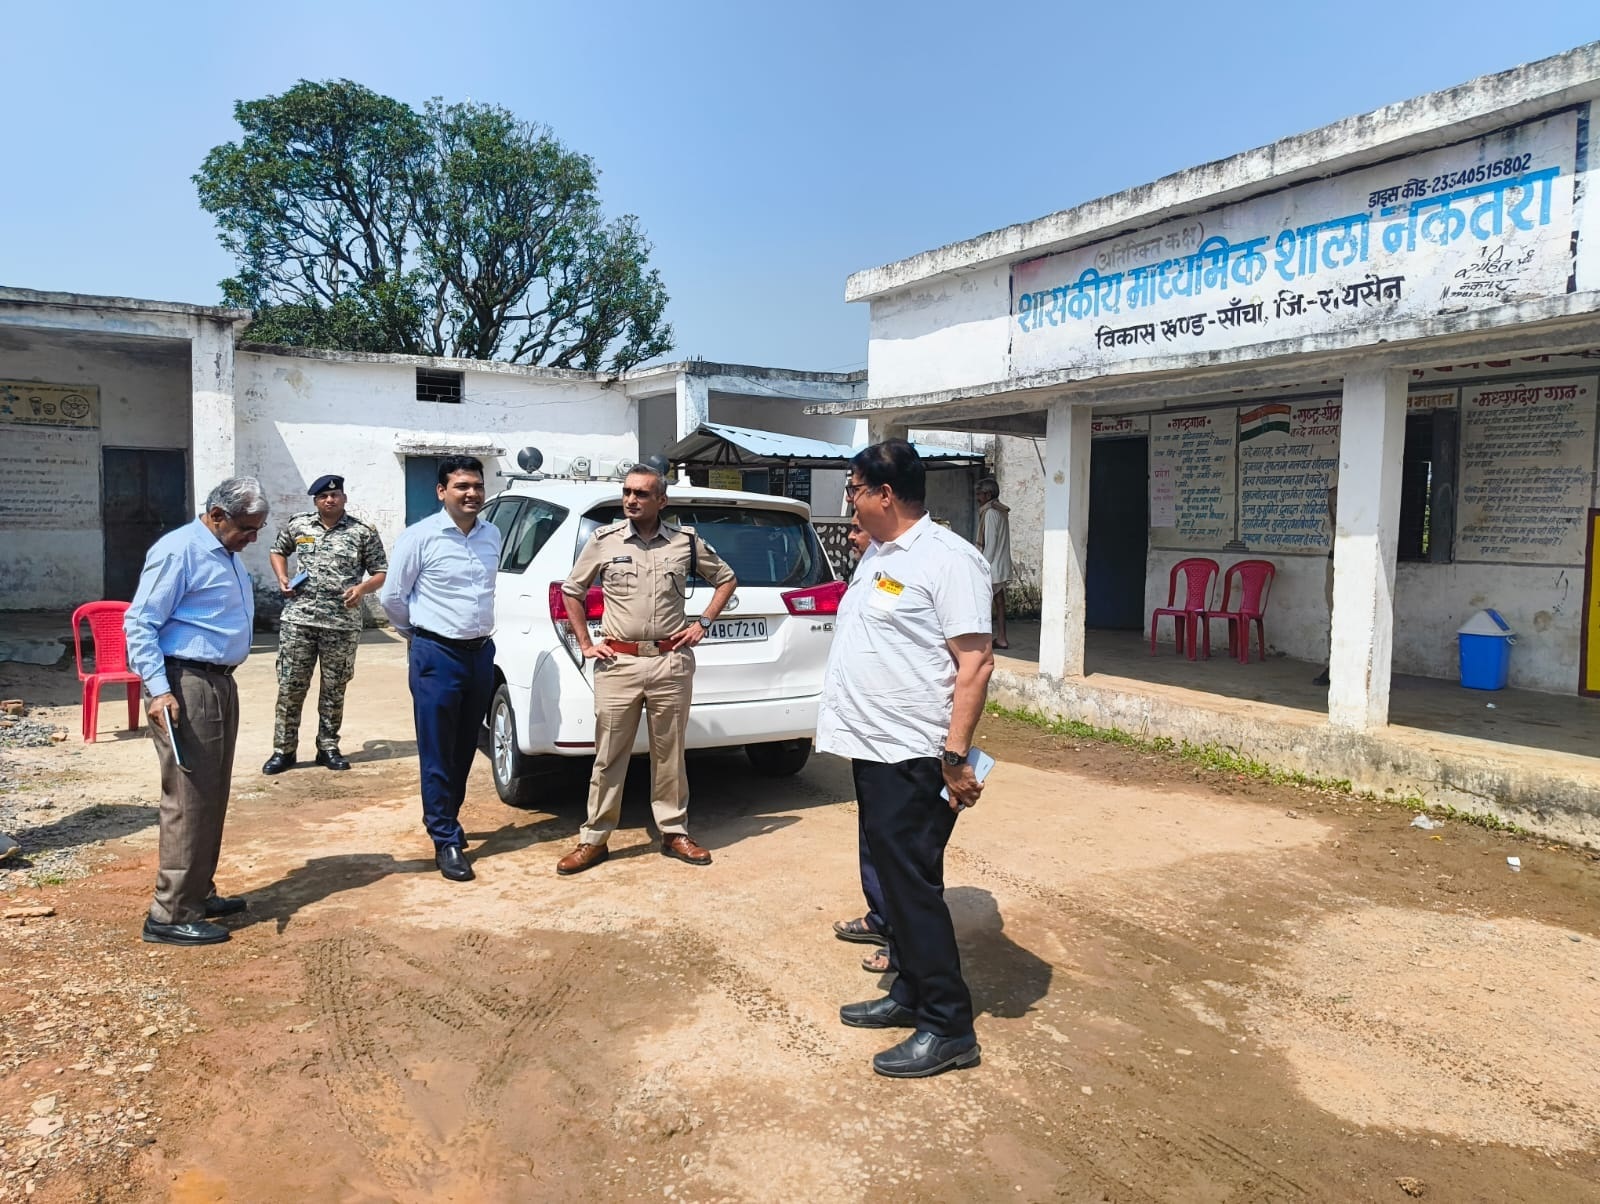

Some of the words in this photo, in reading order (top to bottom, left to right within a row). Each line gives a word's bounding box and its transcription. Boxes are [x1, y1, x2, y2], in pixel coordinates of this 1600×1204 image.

[1368, 185, 1403, 208] डाइस
[1018, 268, 1125, 332] शासकीय
[1127, 235, 1270, 309] माध्यमिक
[1274, 212, 1373, 281] शाला
[1380, 166, 1560, 254] नकतरा
[1095, 320, 1155, 349] विकास
[1478, 384, 1543, 408] मध्यप्रदेश
[1544, 385, 1578, 401] गान
